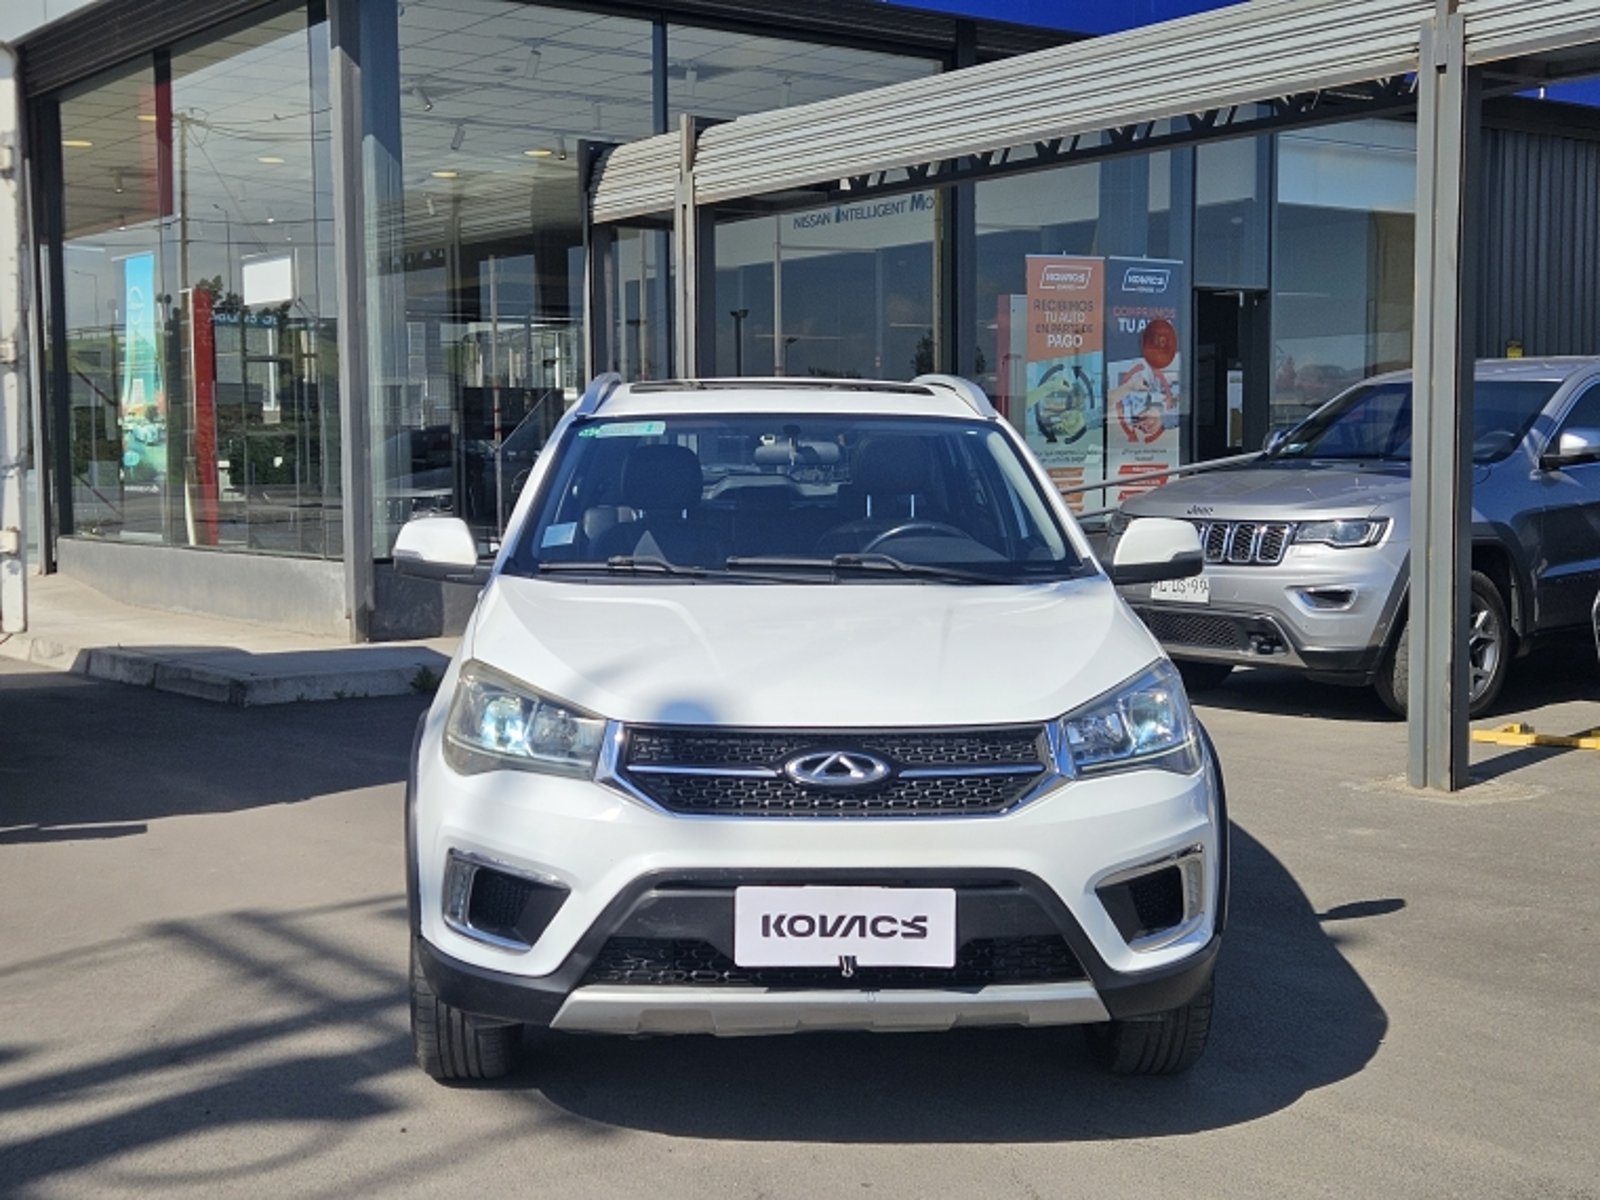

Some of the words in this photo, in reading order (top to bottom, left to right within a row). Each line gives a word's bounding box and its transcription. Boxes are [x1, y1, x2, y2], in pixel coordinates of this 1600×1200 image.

[793, 212, 831, 229] NISSAN
[835, 200, 906, 223] INTELLIGENT
[1033, 299, 1094, 312] RECIBIMOS
[1045, 311, 1057, 323] TU
[1059, 312, 1086, 323] AUTO
[1118, 317, 1136, 333] TU
[1047, 334, 1084, 348] PAGO
[762, 914, 928, 939] KOVACS
